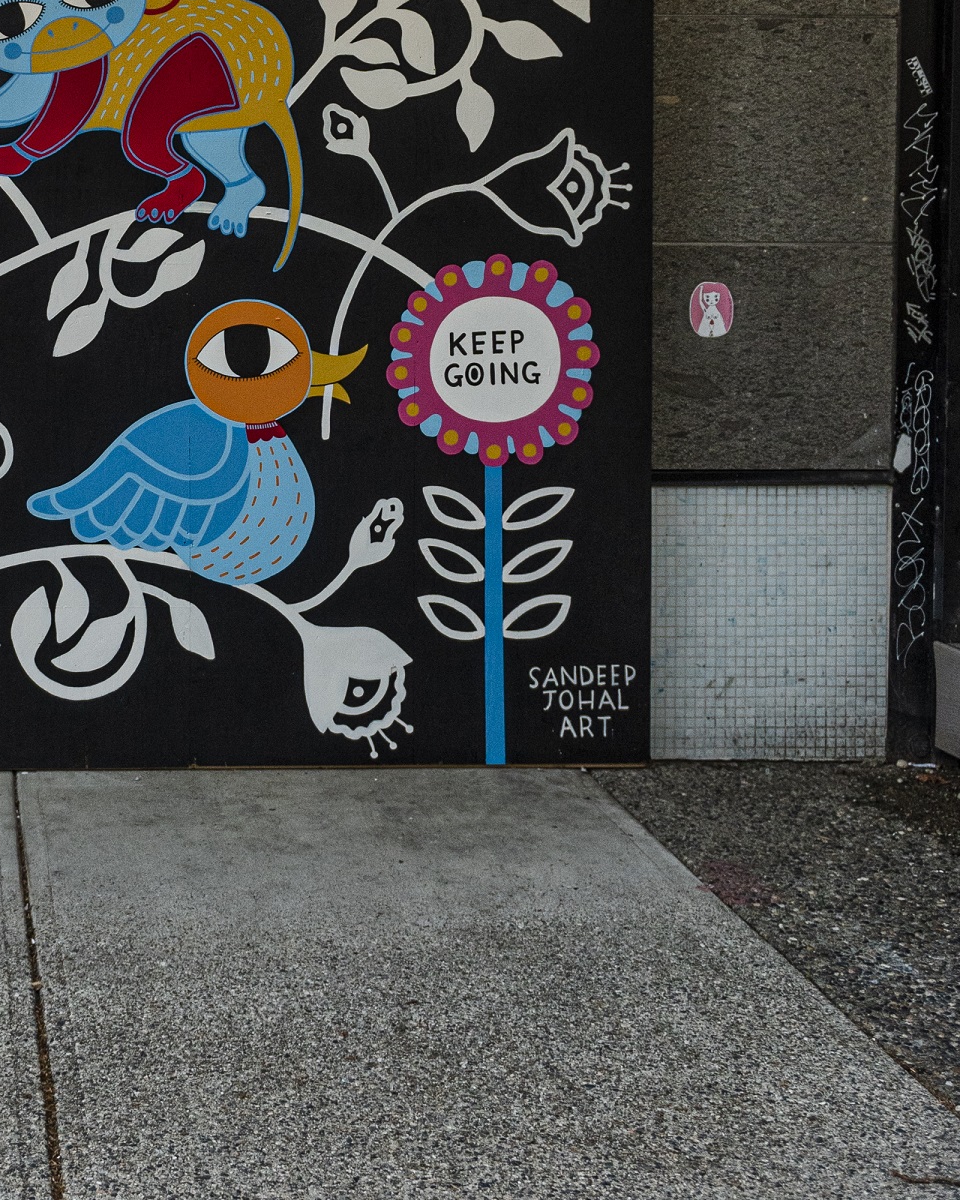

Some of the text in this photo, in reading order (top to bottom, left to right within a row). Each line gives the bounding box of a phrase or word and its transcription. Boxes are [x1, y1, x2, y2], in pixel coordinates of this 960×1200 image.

[449, 330, 525, 356] KEEP
[444, 361, 541, 387] GOING
[528, 664, 637, 689] SANDEEP
[542, 689, 630, 711] JOHAL
[560, 715, 611, 738] ART
